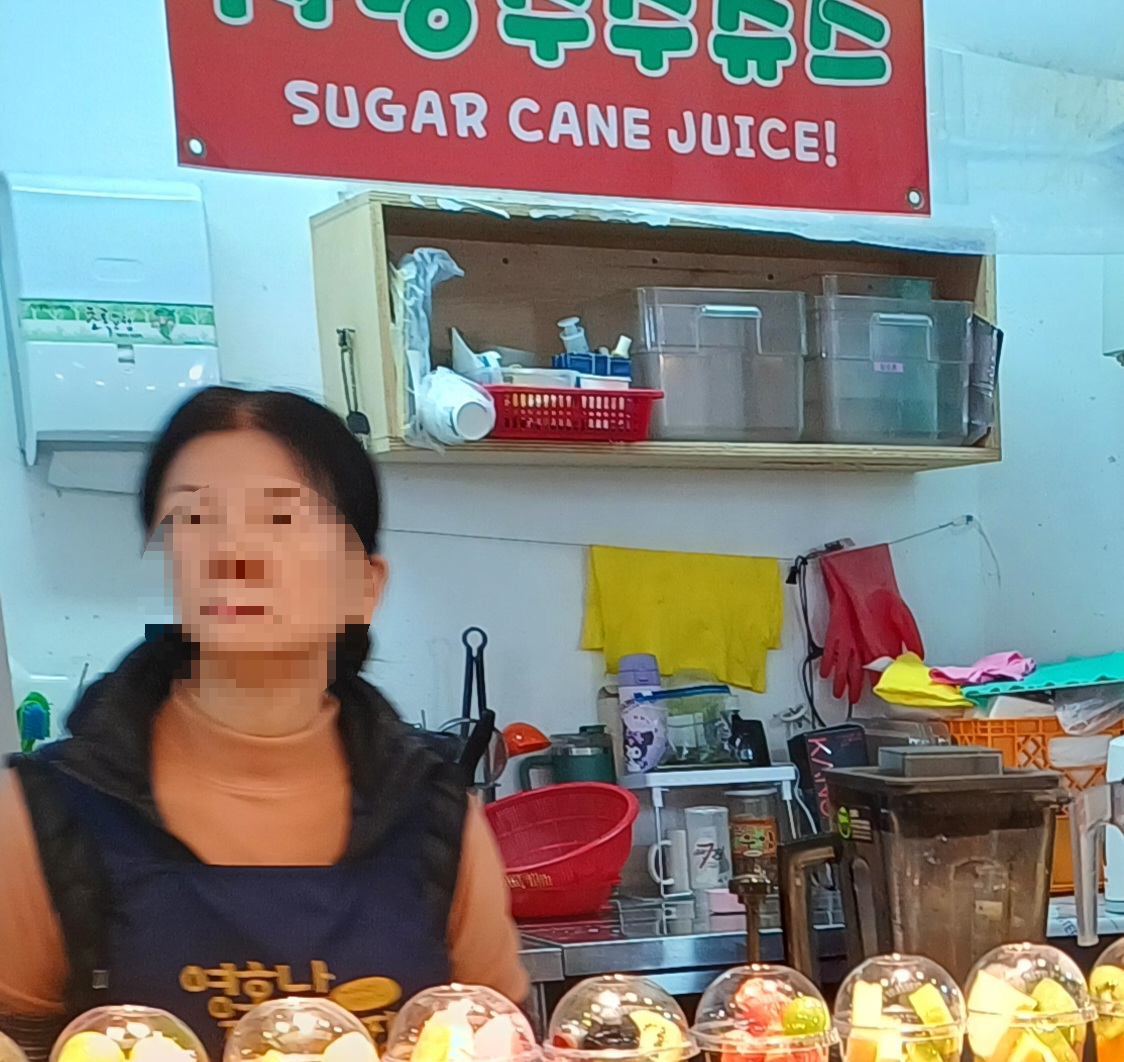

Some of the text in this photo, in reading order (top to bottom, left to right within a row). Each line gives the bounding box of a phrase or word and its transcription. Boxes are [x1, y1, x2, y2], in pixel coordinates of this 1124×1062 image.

[284, 80, 838, 168] SUGAR CANE JUICE!
